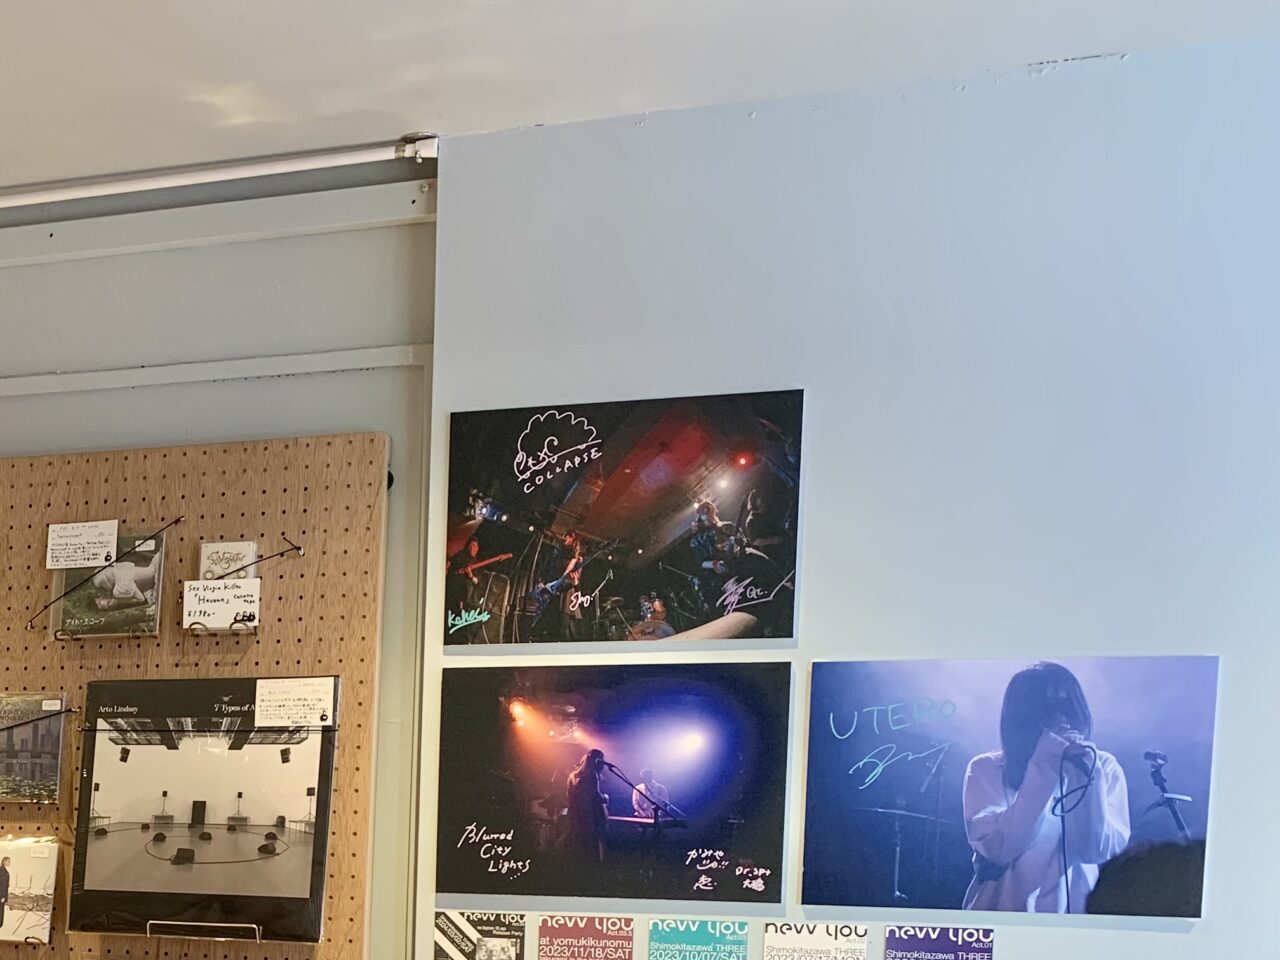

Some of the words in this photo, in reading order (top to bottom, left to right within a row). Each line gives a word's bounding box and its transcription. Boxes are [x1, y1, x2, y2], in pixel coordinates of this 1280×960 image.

[524, 448, 602, 493] COLLAPSE
[98, 705, 113, 713] Arto
[114, 706, 138, 714] Lindsay
[222, 704, 240, 712] Types
[241, 704, 249, 712] of
[457, 822, 514, 847] Blurred
[480, 843, 512, 860] City
[488, 859, 531, 873] Lights
[540, 937, 550, 945] at
[553, 937, 632, 948] yomukikunomu
[650, 942, 713, 951] Shimokitazawa
[715, 944, 746, 952] THREE
[540, 946, 631, 959] 2023/11/18/SAT
[766, 946, 831, 955] Shimokitazawa
[834, 948, 865, 956] THREE
[886, 950, 954, 960] Shimokitazawa
[957, 952, 992, 960] THREE
